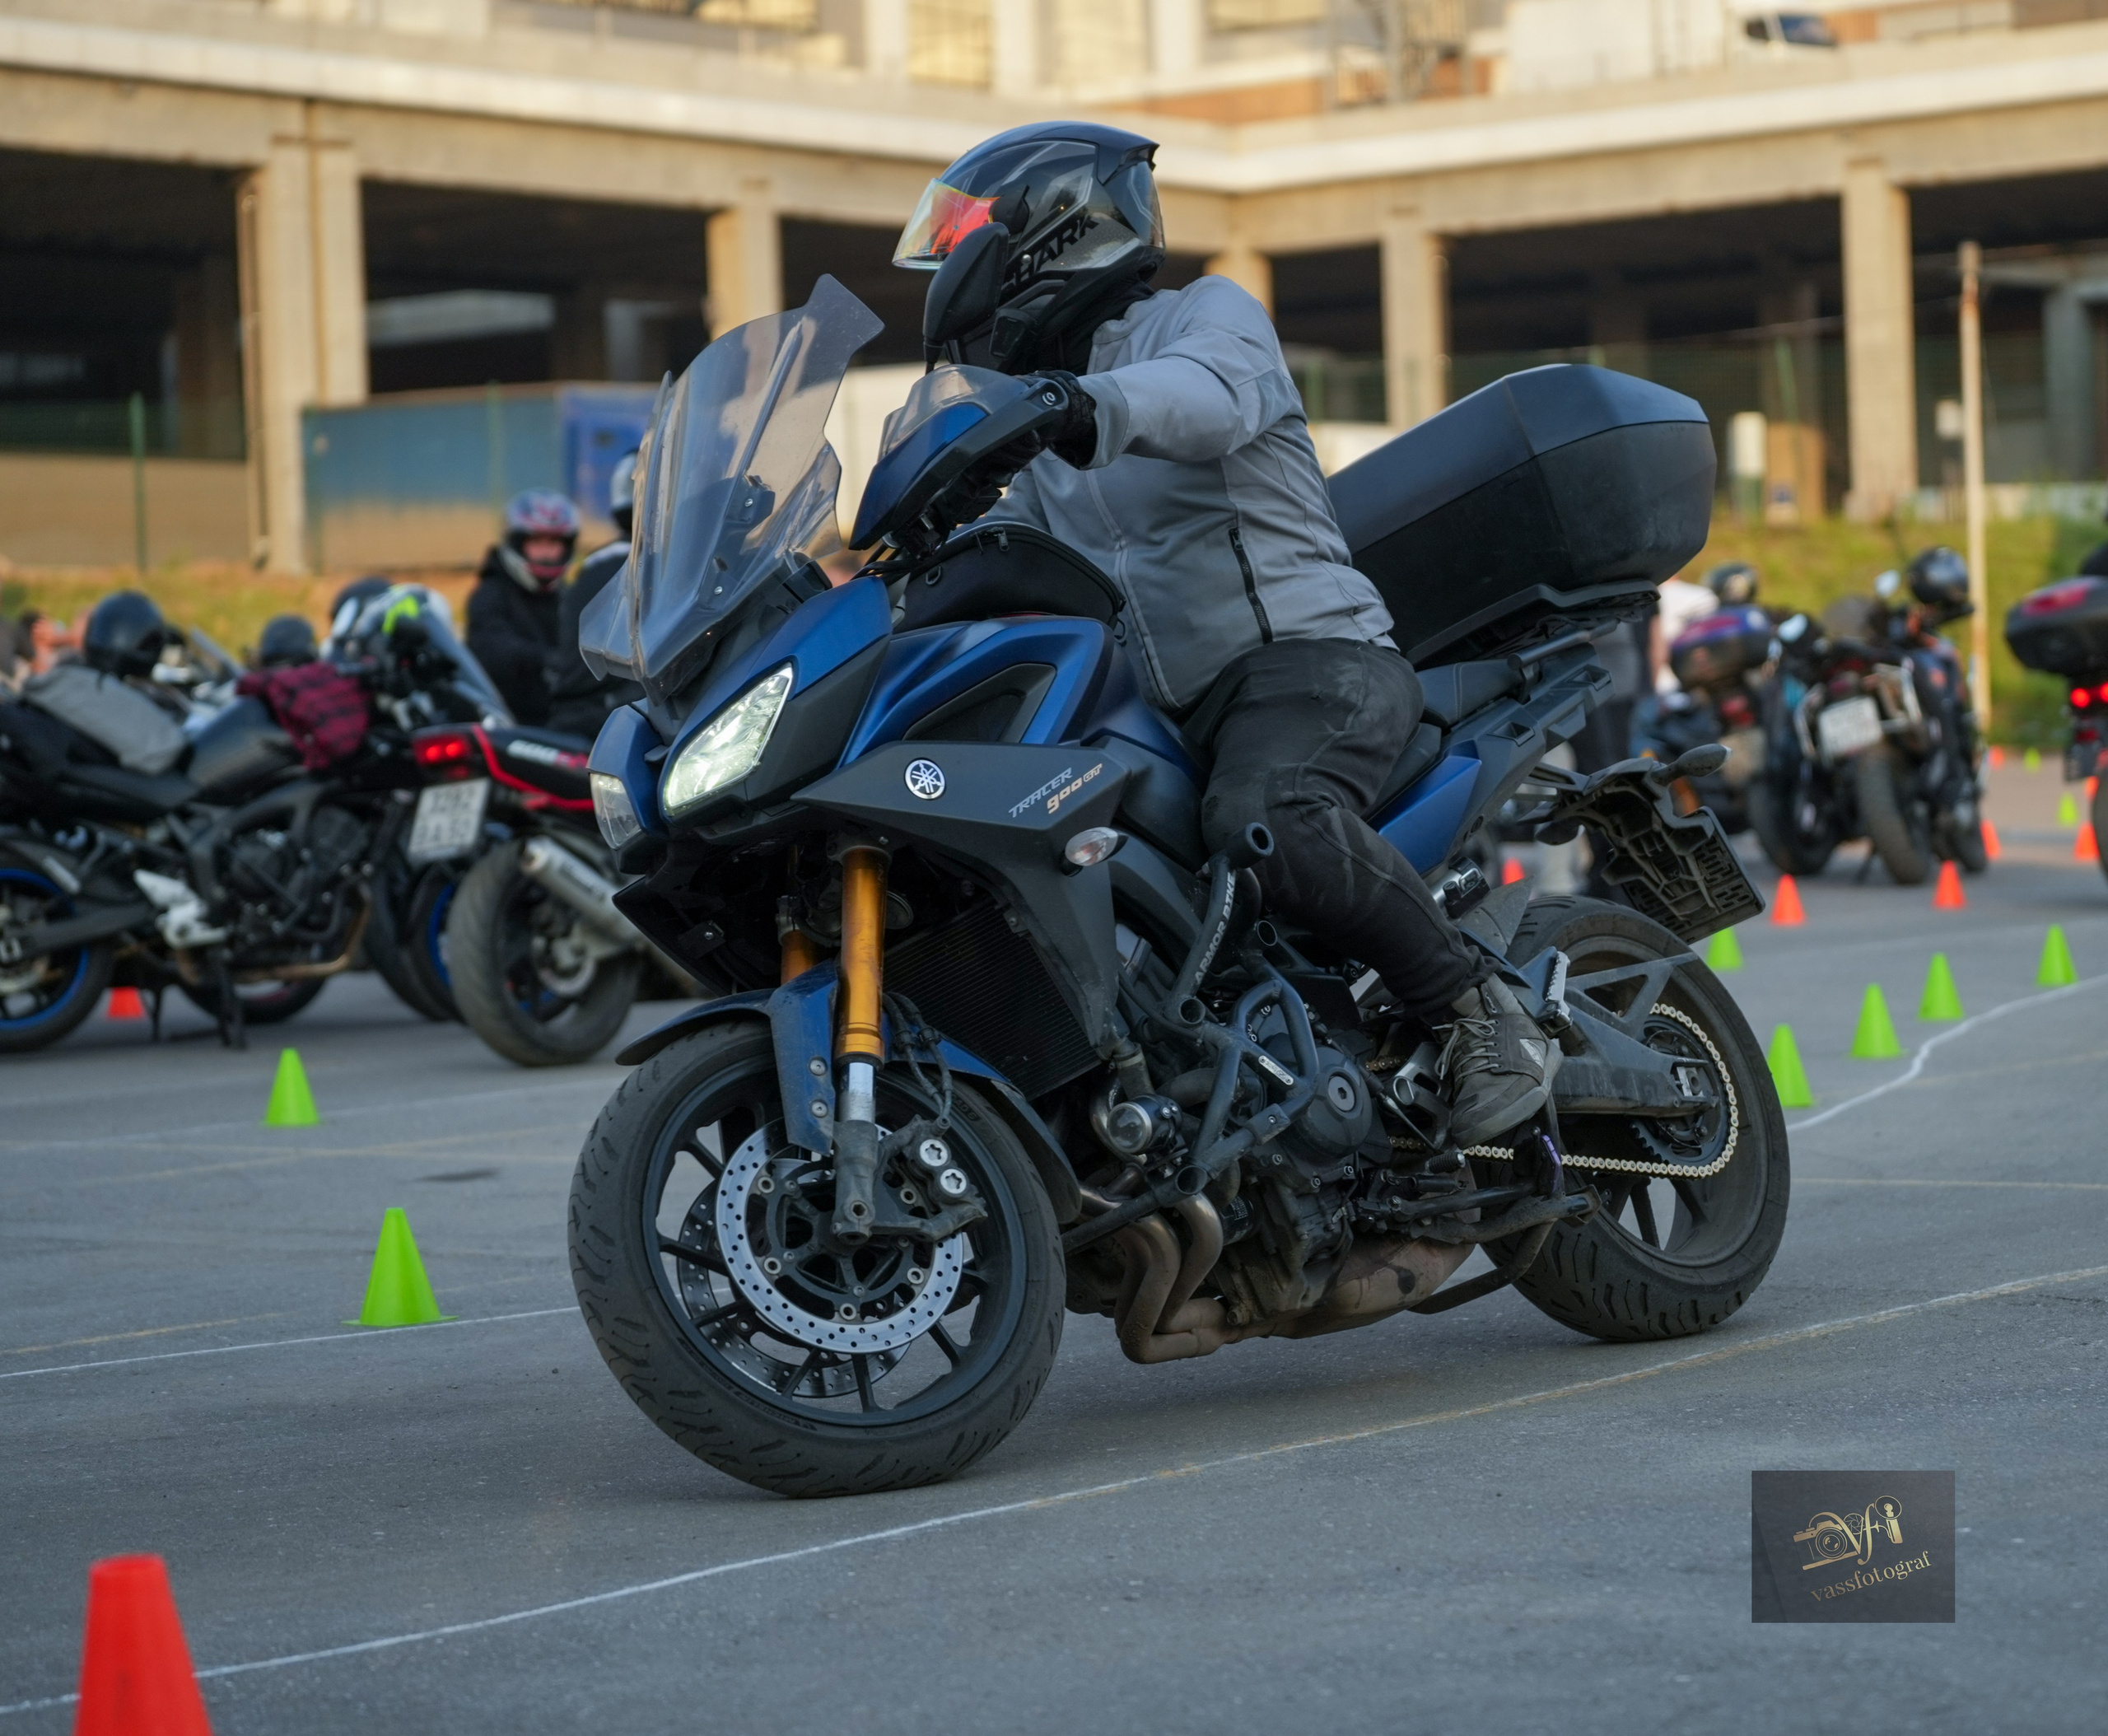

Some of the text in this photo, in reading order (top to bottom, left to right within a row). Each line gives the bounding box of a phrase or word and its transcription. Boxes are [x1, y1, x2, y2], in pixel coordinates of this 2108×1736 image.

[1008, 767, 1073, 818] TRACER
[1194, 871, 1236, 985] ARMOR BIKE
